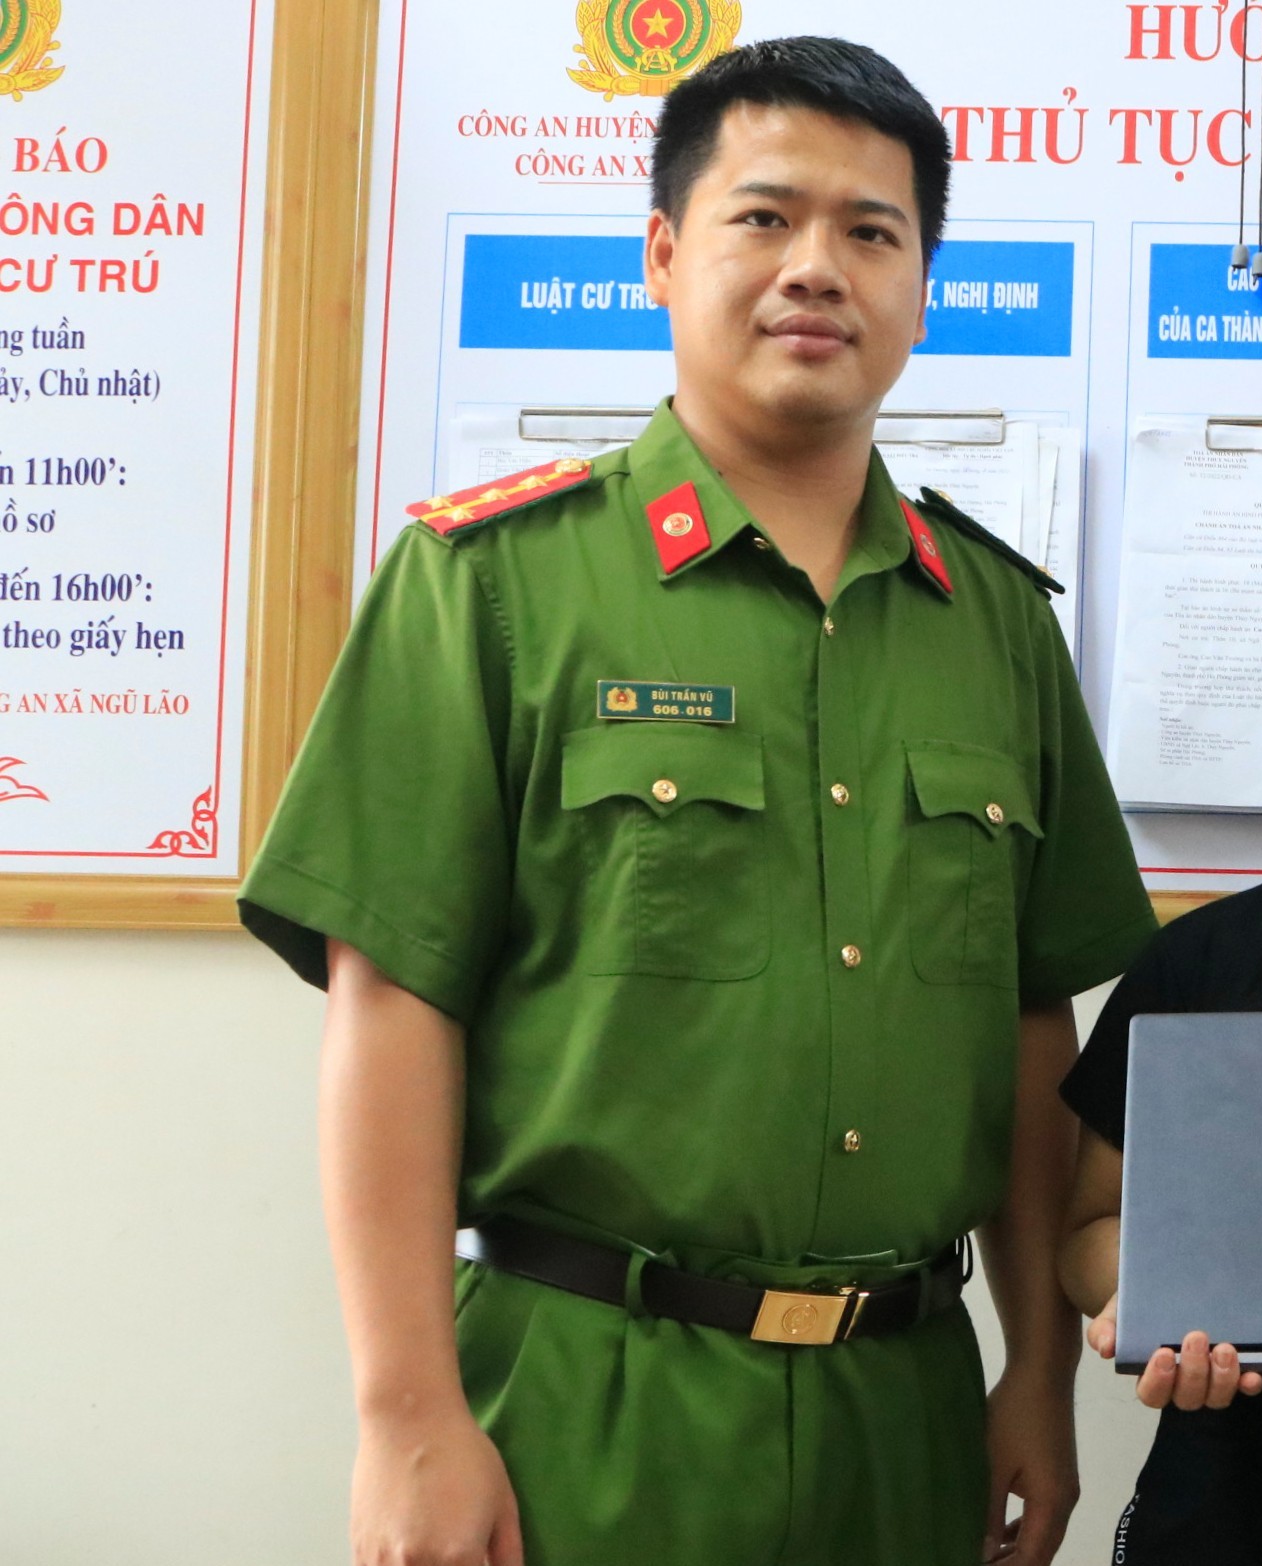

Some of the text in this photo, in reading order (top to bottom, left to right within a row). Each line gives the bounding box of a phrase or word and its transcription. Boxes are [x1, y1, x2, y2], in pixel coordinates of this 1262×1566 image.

[458, 109, 661, 145] CÔNG AN HUYỆN
[940, 86, 1089, 164] THỦ
[1109, 108, 1252, 183] TỤC
[12, 126, 108, 173] BÁO
[515, 148, 625, 176] CÔNG AN
[113, 193, 204, 236] DÂN
[70, 250, 159, 293] TRÚ
[521, 277, 615, 314] LUẬT CƯ
[943, 281, 1039, 314] NGHỊ ĐỊNH
[32, 316, 84, 349] tuần
[1159, 306, 1192, 341] CỦA
[1196, 315, 1218, 342] CA
[39, 368, 160, 404] Chủ nhật)
[27, 510, 55, 533] sơ
[3, 615, 184, 658] theo giấy hẹn
[17, 693, 47, 713] AN
[54, 689, 83, 713] XÃ
[90, 689, 137, 714] NGŨ
[143, 689, 189, 714] LÃO
